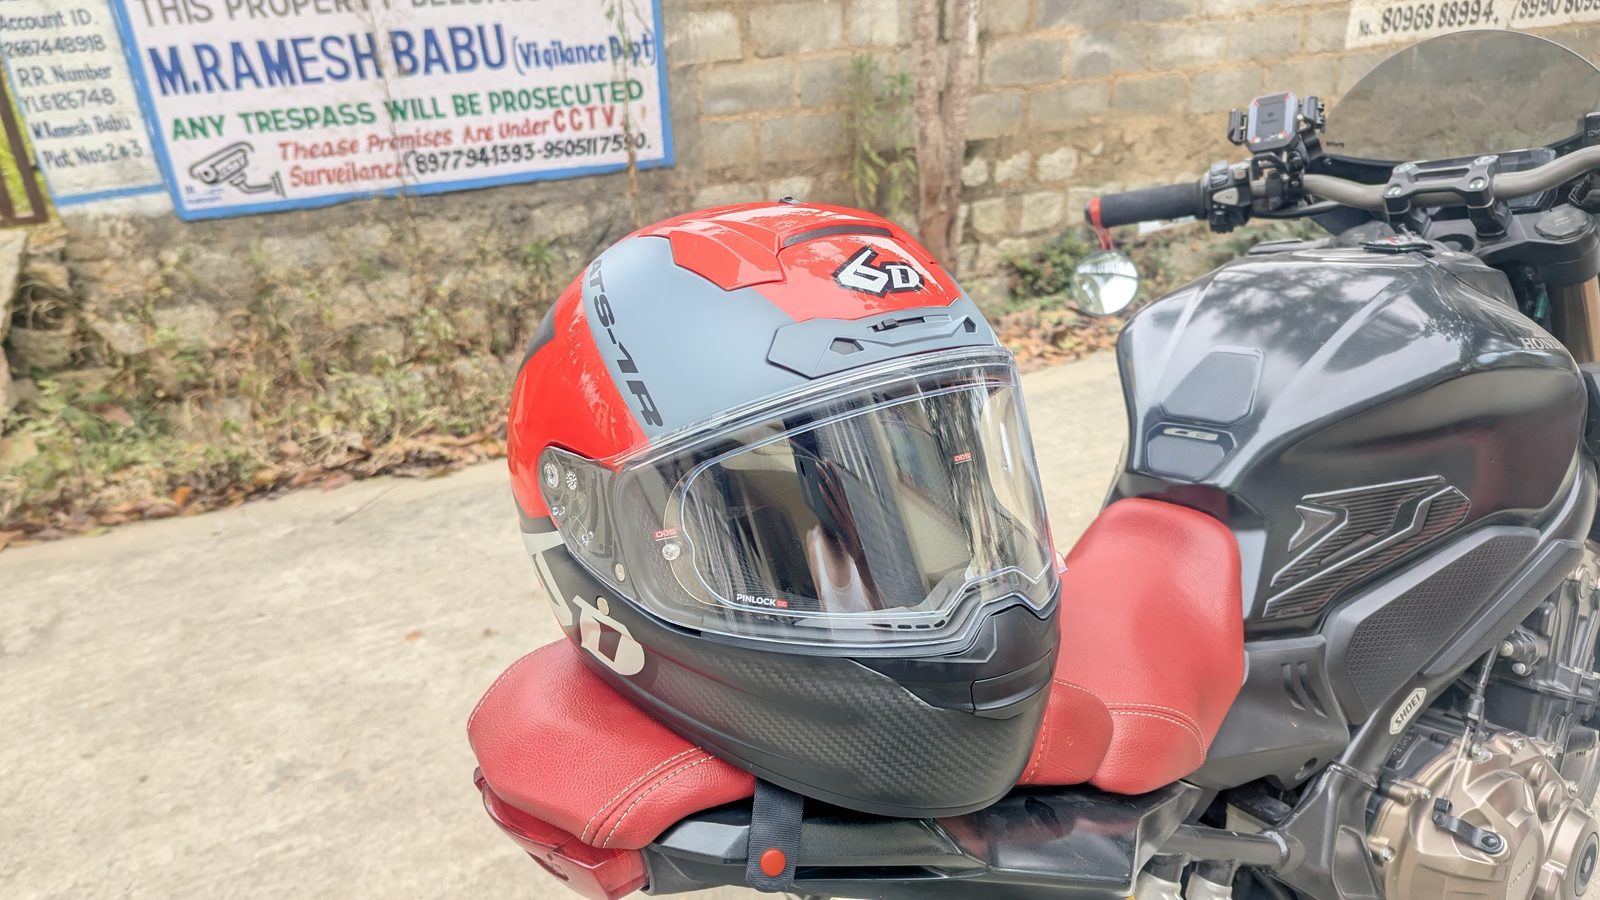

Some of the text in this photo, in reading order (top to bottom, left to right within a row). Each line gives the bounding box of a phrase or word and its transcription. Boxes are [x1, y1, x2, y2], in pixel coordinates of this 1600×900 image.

[140, 0, 214, 27] THIS
[147, 32, 384, 96] M.RAMESH
[388, 24, 508, 77] BABU
[609, 30, 656, 67] Dpt)
[172, 78, 645, 141] ANY TRESPASS WILL BE PROSECUTED
[278, 139, 359, 161] Thease
[367, 129, 452, 152] Premises
[498, 119, 549, 138] Under
[589, 259, 664, 427] ATS-1R
[1519, 336, 1563, 350] HOND
[736, 593, 776, 607] PINLOCK
[1394, 693, 1421, 727] SHOEI
